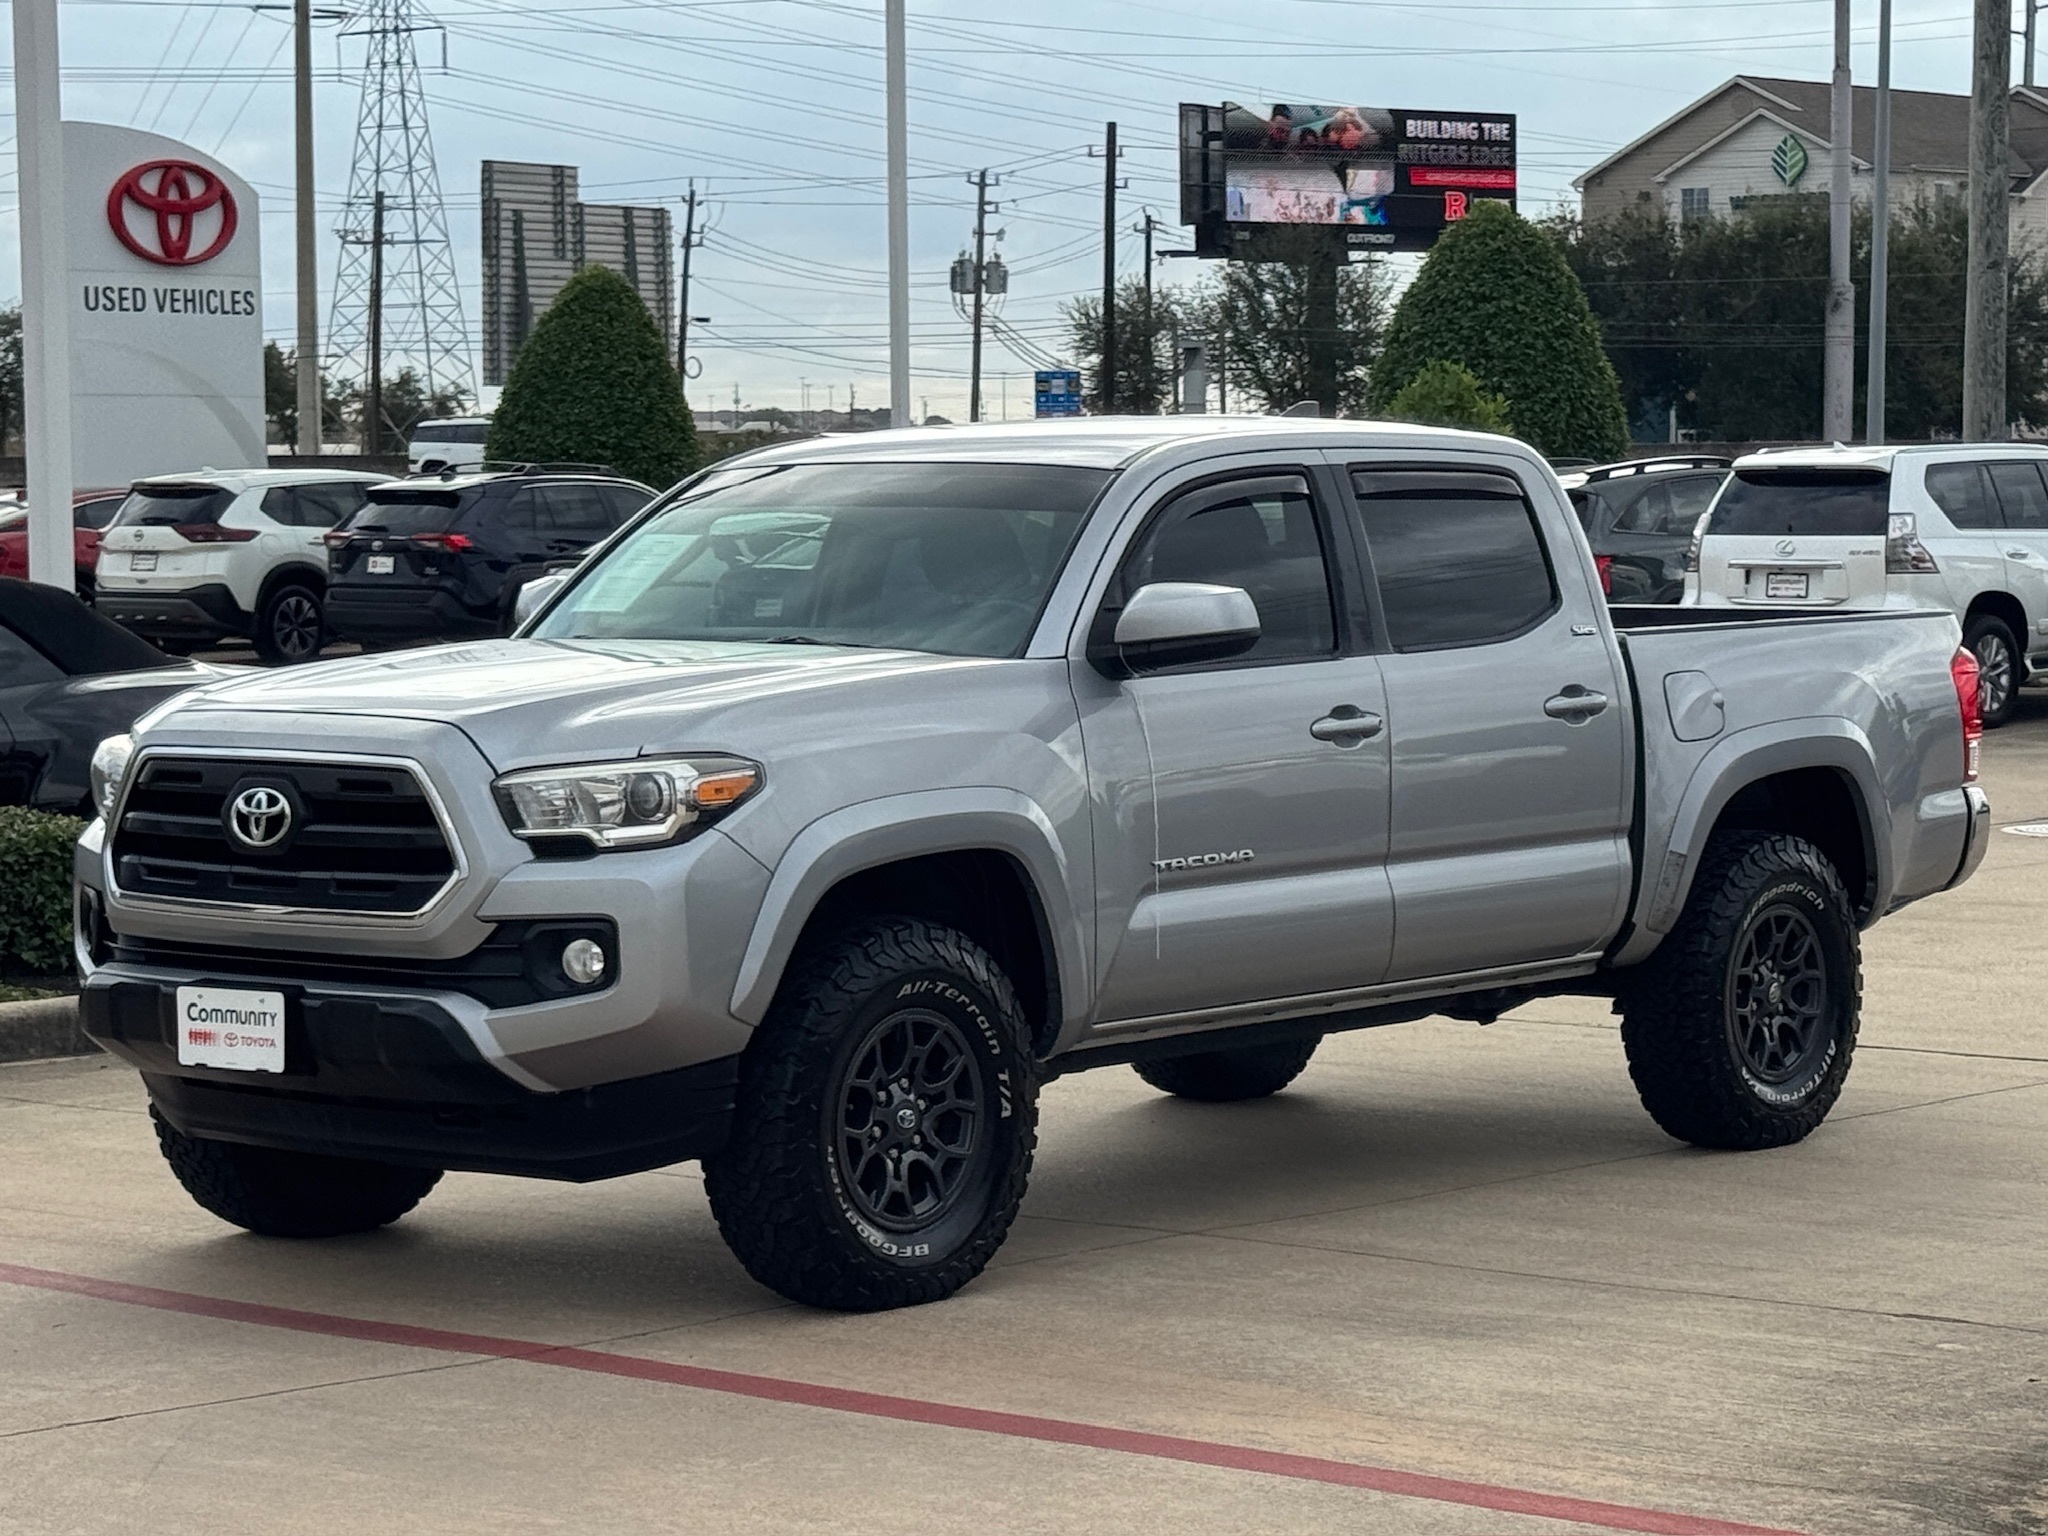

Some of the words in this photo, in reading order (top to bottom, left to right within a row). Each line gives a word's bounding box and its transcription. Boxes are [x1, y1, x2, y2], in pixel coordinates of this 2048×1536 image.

[1405, 119, 1479, 140] BUILDING
[1481, 122, 1511, 141] THE
[84, 285, 147, 312] USED
[153, 287, 256, 316] VEHICLES
[1150, 848, 1255, 872] TACOMA
[241, 1036, 277, 1048] TOYOTA
